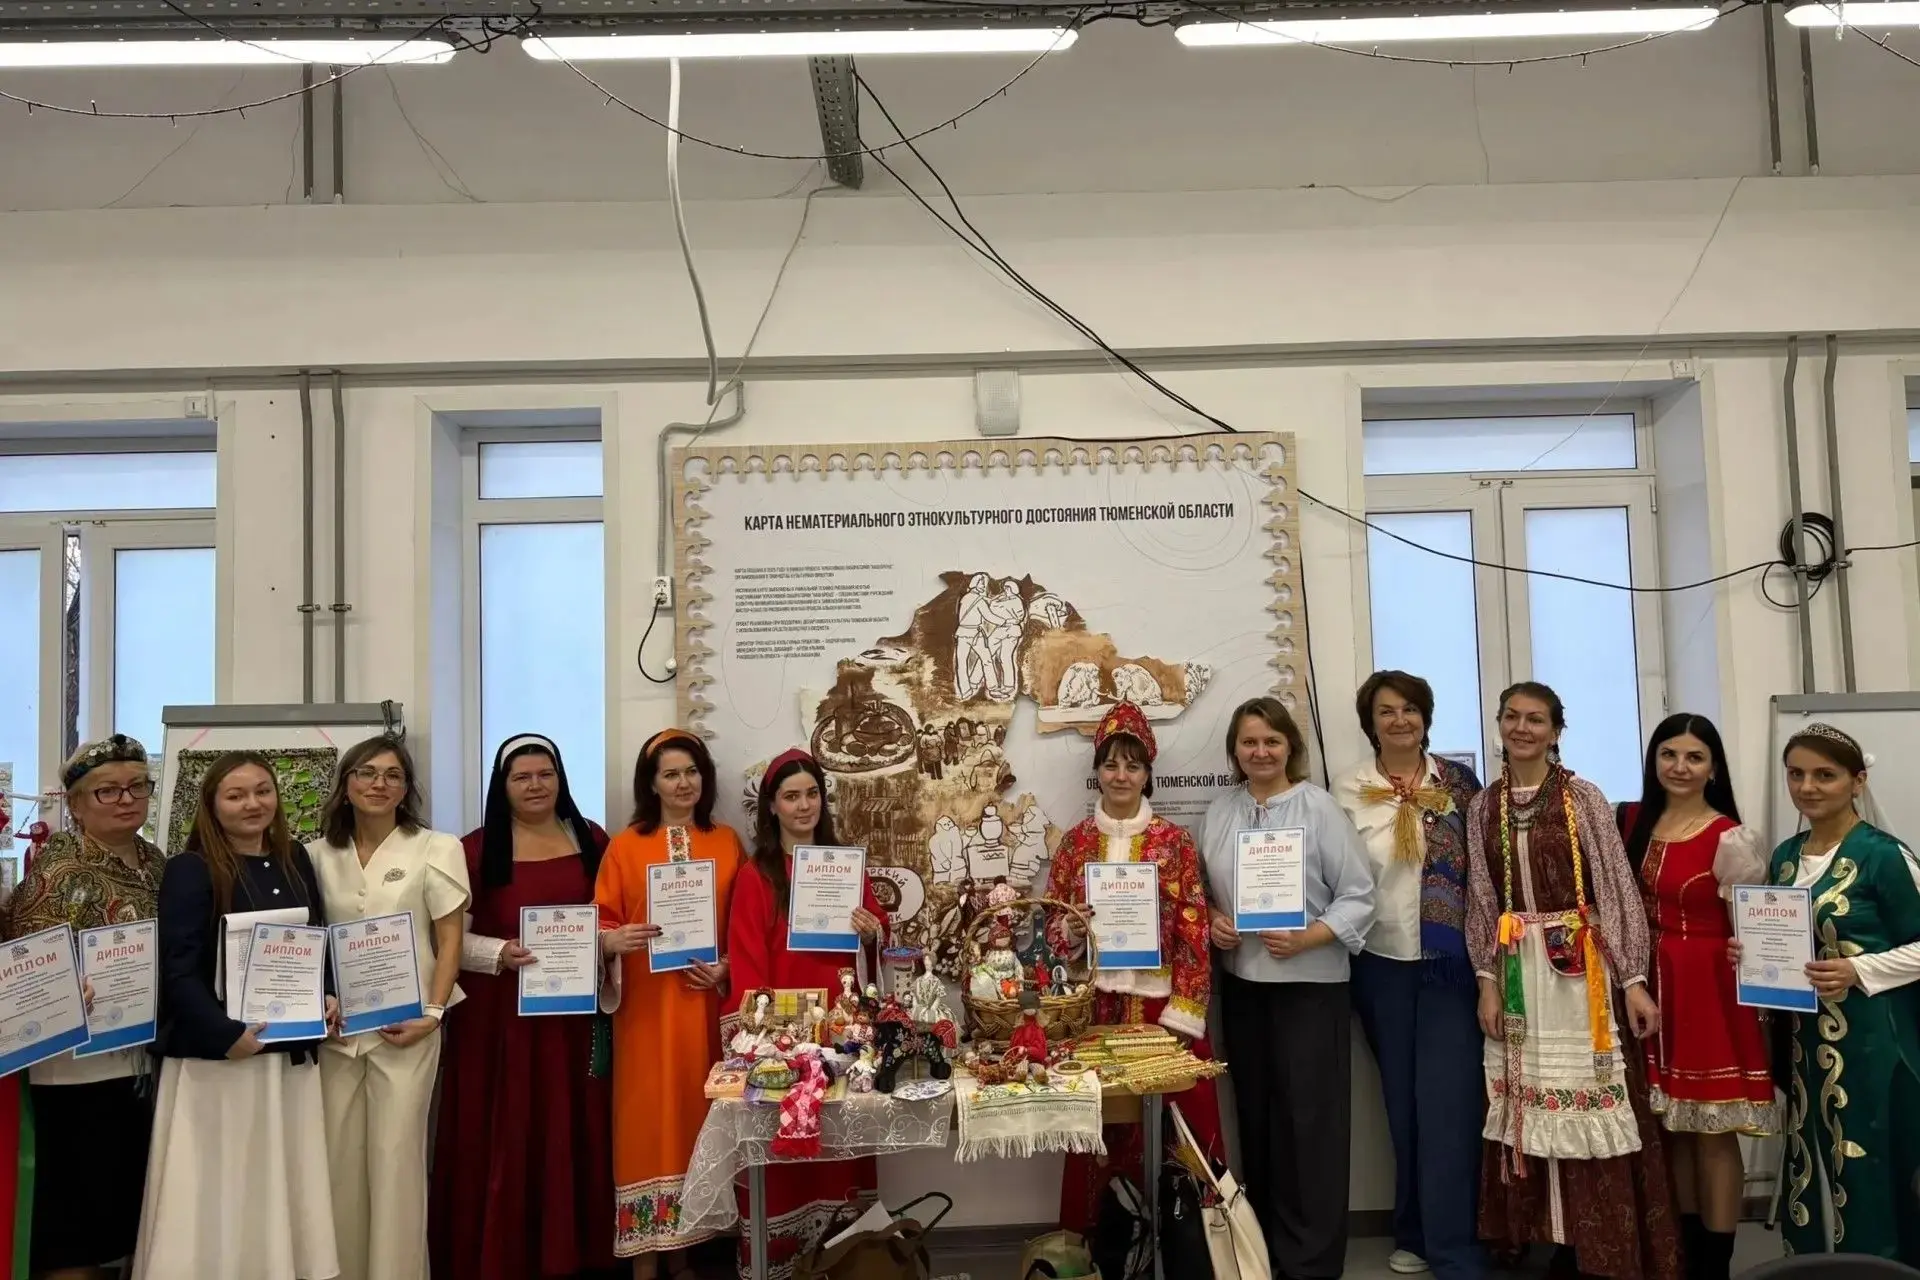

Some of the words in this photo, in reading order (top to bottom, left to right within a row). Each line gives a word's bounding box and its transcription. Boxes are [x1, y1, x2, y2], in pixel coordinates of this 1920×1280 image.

[744, 515, 784, 531] КАРТА
[786, 512, 905, 529] НЕМАТЕРИАЛЬНОГО
[908, 509, 1023, 527] ЭТНОКУЛЬТУРНОГО
[1026, 507, 1097, 525] ДОСТОЯНИЯ
[1099, 502, 1175, 521] ТЮМЕНСКОЙ
[1178, 503, 1234, 519] ОБЛАСТИ
[1156, 772, 1216, 788] ТЮМЕНСКОЙ
[1249, 845, 1293, 855] ДИПЛОМ
[806, 864, 851, 874] ДИПЛОМ
[870, 868, 908, 888] РСКИЙ
[661, 879, 704, 891] ДИПЛОМ
[1100, 881, 1145, 891] ДИПЛОМ
[1748, 907, 1797, 918] ДИПЛОМ
[536, 925, 584, 934] ДИПЛОМ
[349, 933, 400, 951] ДИПЛОМ
[96, 943, 145, 962] ДИПЛОМ
[264, 944, 312, 956] ДИПЛОМ
[0, 952, 57, 981] ИПЛОМ
